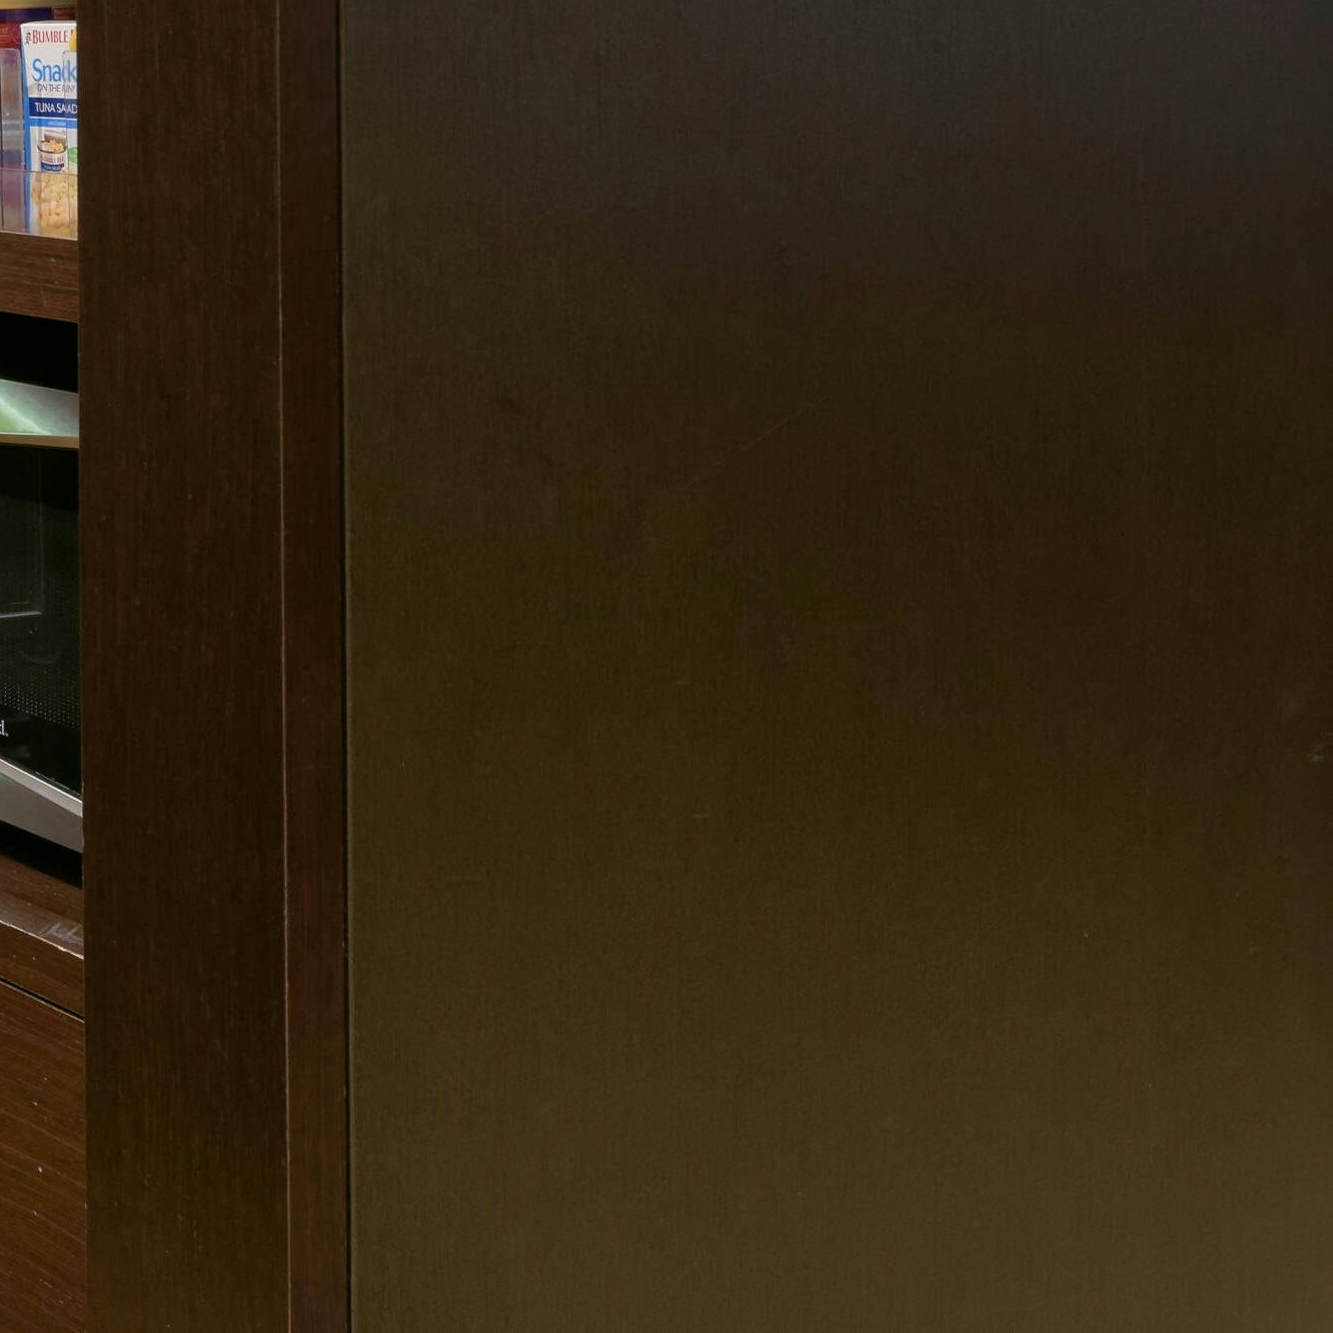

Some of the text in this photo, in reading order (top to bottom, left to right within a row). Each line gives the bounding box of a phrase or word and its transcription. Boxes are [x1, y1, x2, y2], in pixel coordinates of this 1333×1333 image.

[32, 30, 69, 44] BUMBLE
[32, 58, 77, 82] Snack
[37, 84, 62, 93] ON THE
[35, 102, 56, 113] TUNA
